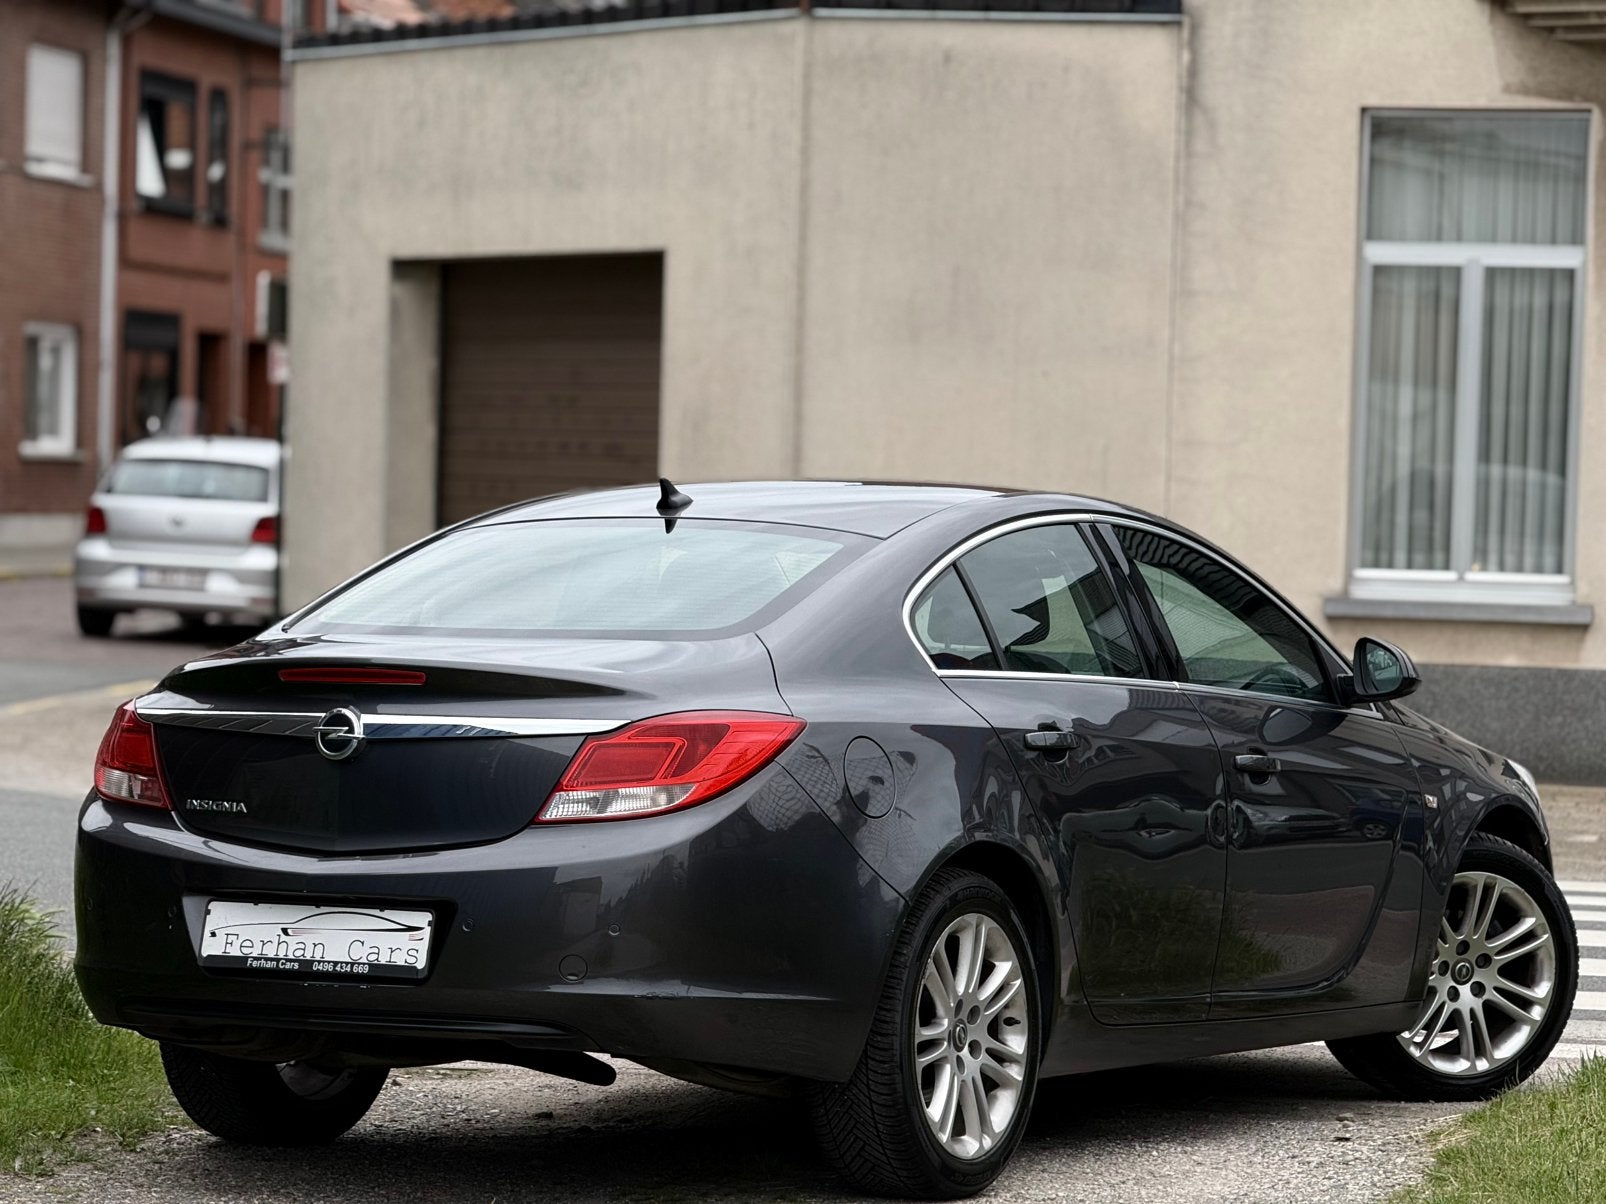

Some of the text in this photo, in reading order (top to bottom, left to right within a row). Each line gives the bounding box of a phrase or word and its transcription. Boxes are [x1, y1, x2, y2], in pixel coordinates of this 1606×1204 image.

[186, 799, 247, 813] INSIGNIA
[221, 932, 419, 966] Ferhan Cars
[246, 957, 369, 974] Ferhan Cars 0496 434 669
